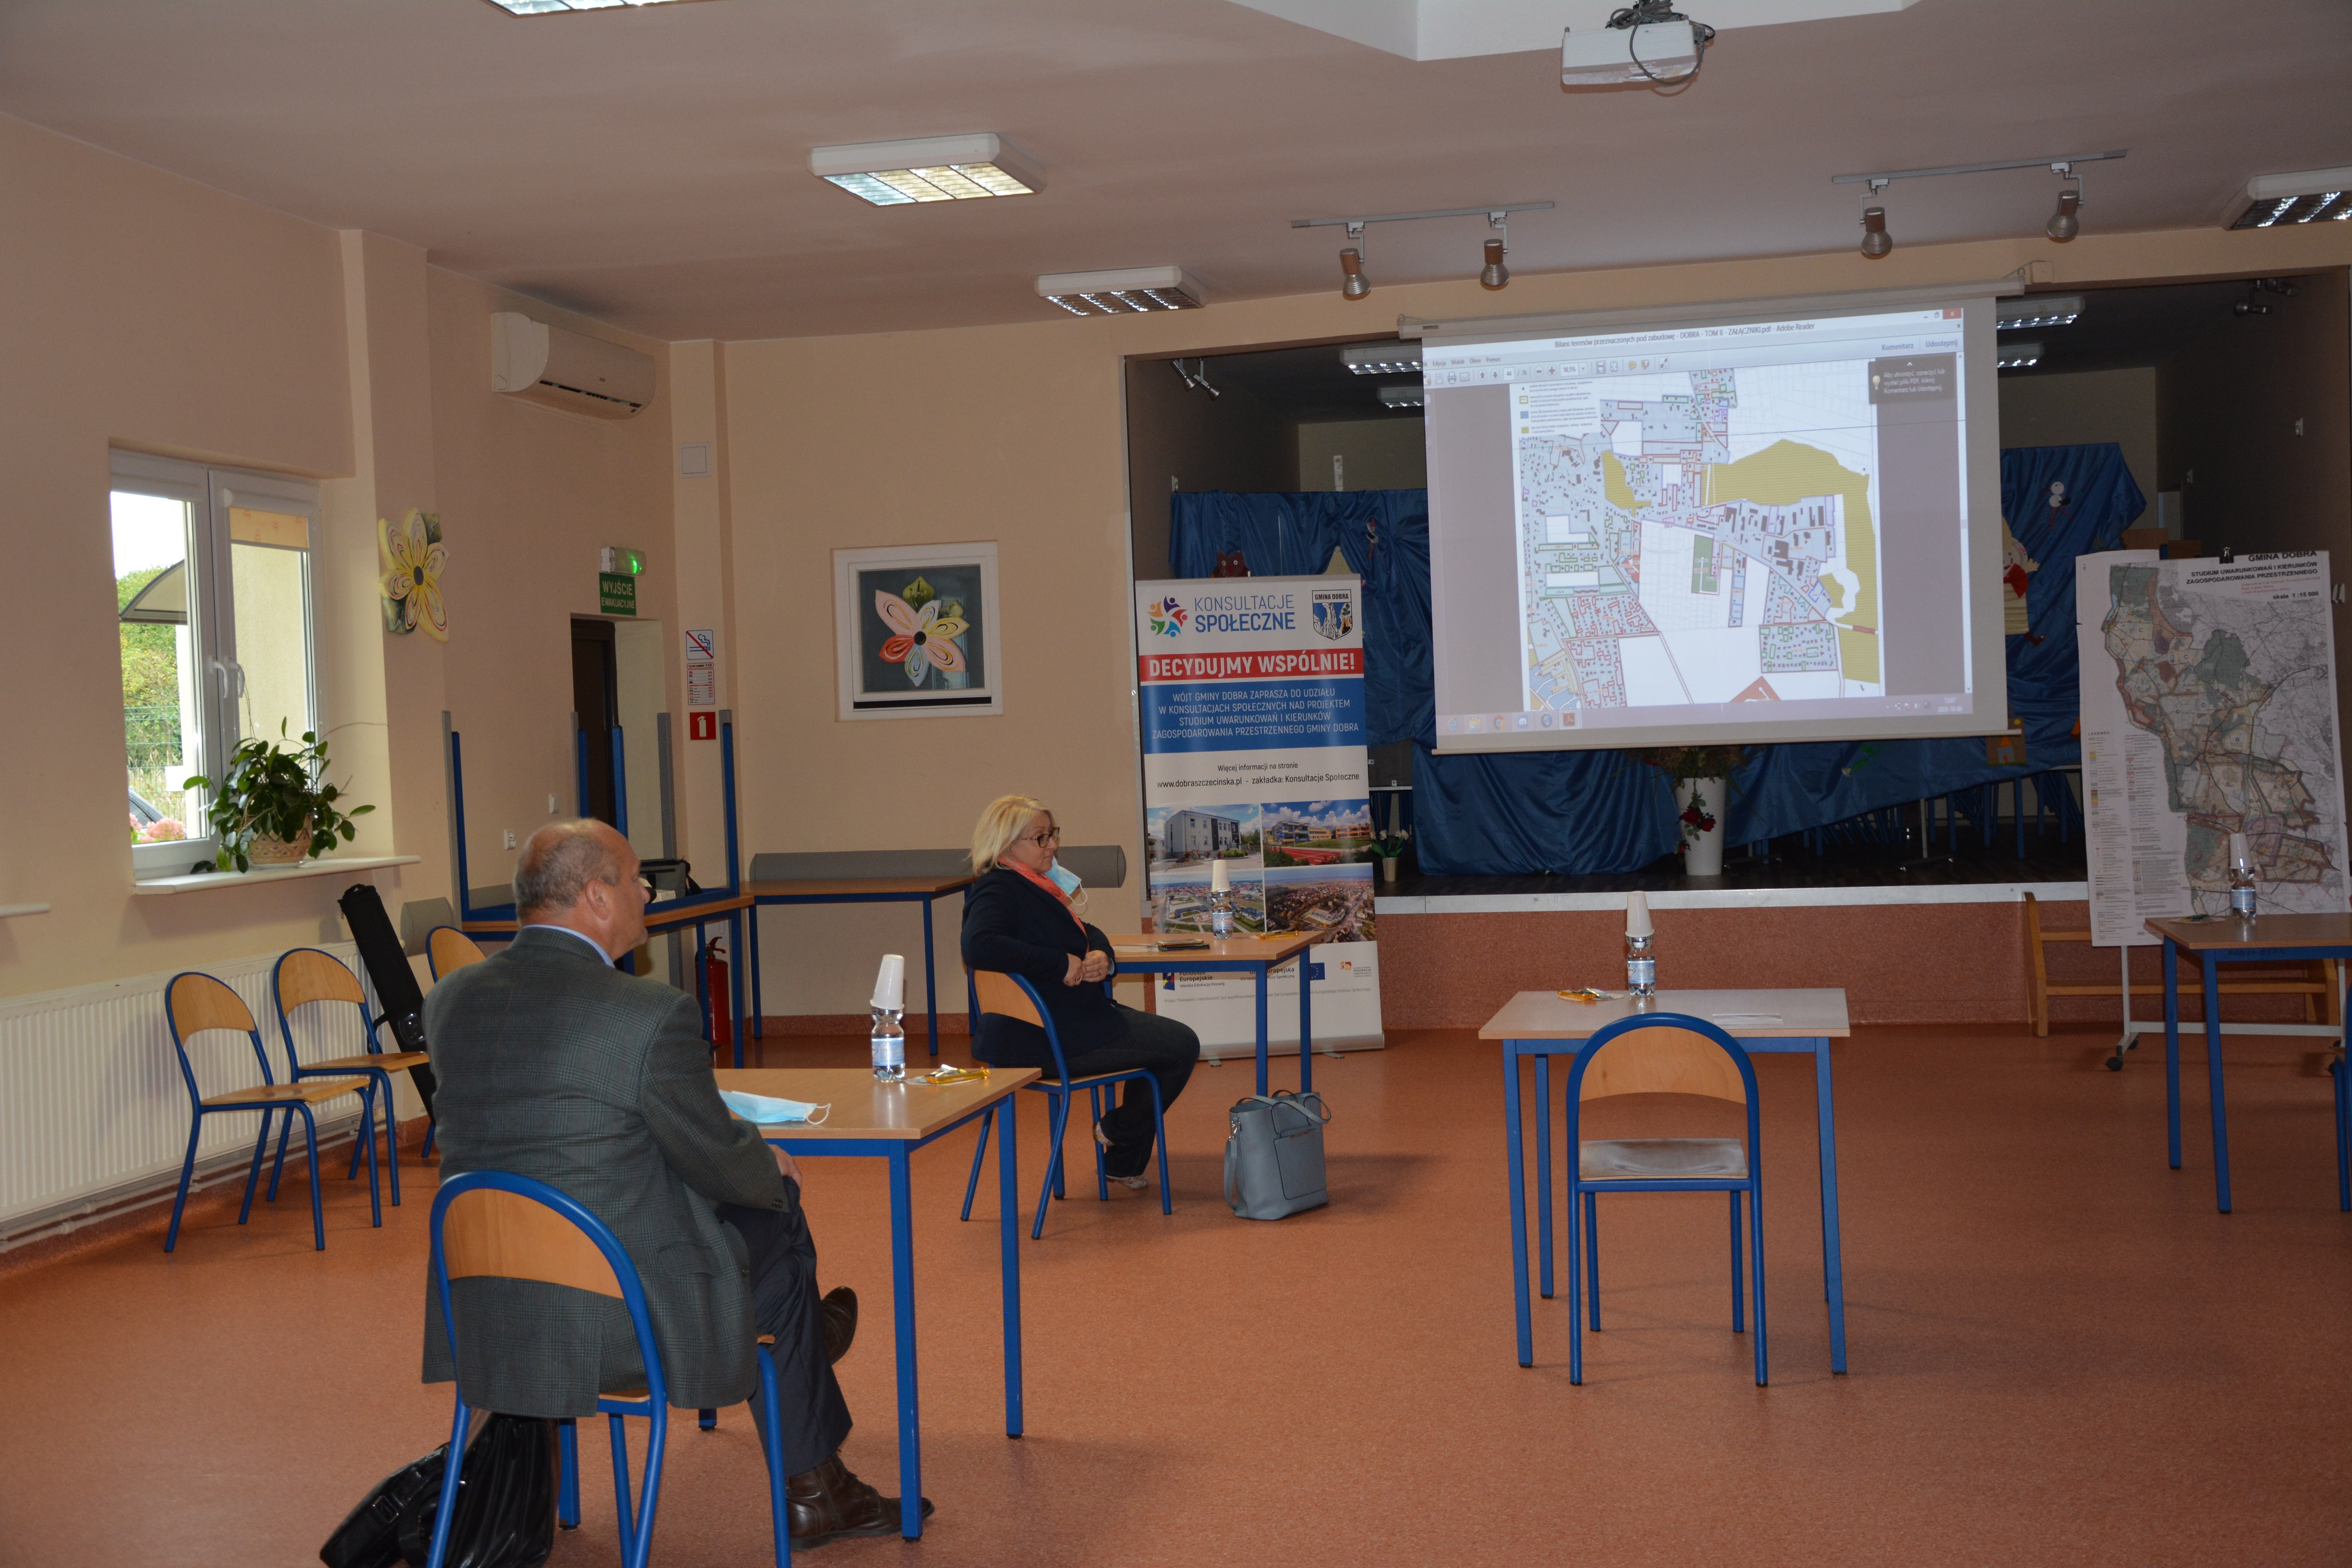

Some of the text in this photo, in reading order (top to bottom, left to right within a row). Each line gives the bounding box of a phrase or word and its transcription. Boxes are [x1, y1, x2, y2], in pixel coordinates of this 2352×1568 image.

[1594, 337, 1635, 346] przeznaczonych
[1636, 336, 1646, 344] pod
[1648, 333, 1675, 341] zabudowę
[1881, 338, 1958, 351] Komentarz Udostępnij
[2249, 551, 2317, 562] GMINA DOBRA
[2220, 564, 2272, 575] UWARUNKOWAŃ
[2278, 561, 2318, 570] KIERUNKÓW
[2186, 569, 2318, 584] ZAGOSPODAROWANIA PRZESTRZENNEGO
[602, 579, 633, 596] WYJŚCIE
[601, 597, 635, 609] EWAKUACYJNE
[1194, 595, 1294, 612] KONSULTACJE
[1195, 612, 1296, 633] SPOŁECZNE
[1150, 650, 1355, 678] DECYDUJMY WSPÓLNIE!
[1173, 688, 1335, 702] WÓJT GMINY DOBRA ZAPRASZA DO UDZIAŁU
[1159, 699, 1350, 715] W KONSULTACJACH SPOŁECZNYCH NAD PROJEKTEM
[1179, 716, 1214, 726] STUDIUM
[1216, 712, 1278, 724] UWARUNKOWAŃ
[1286, 711, 1331, 721] KIERUNKÓW
[1152, 722, 1359, 739] ZAGOSPODAROWANIA PRZESTRZENNEGO GMINY DOBRA
[1239, 763, 1268, 771] informacji
[1156, 777, 1242, 788] www.dobraszczecinska.pl
[1252, 776, 1284, 785] zakładka:
[1285, 774, 1325, 784] Konsultacje
[1326, 773, 1360, 782] Społeczne
